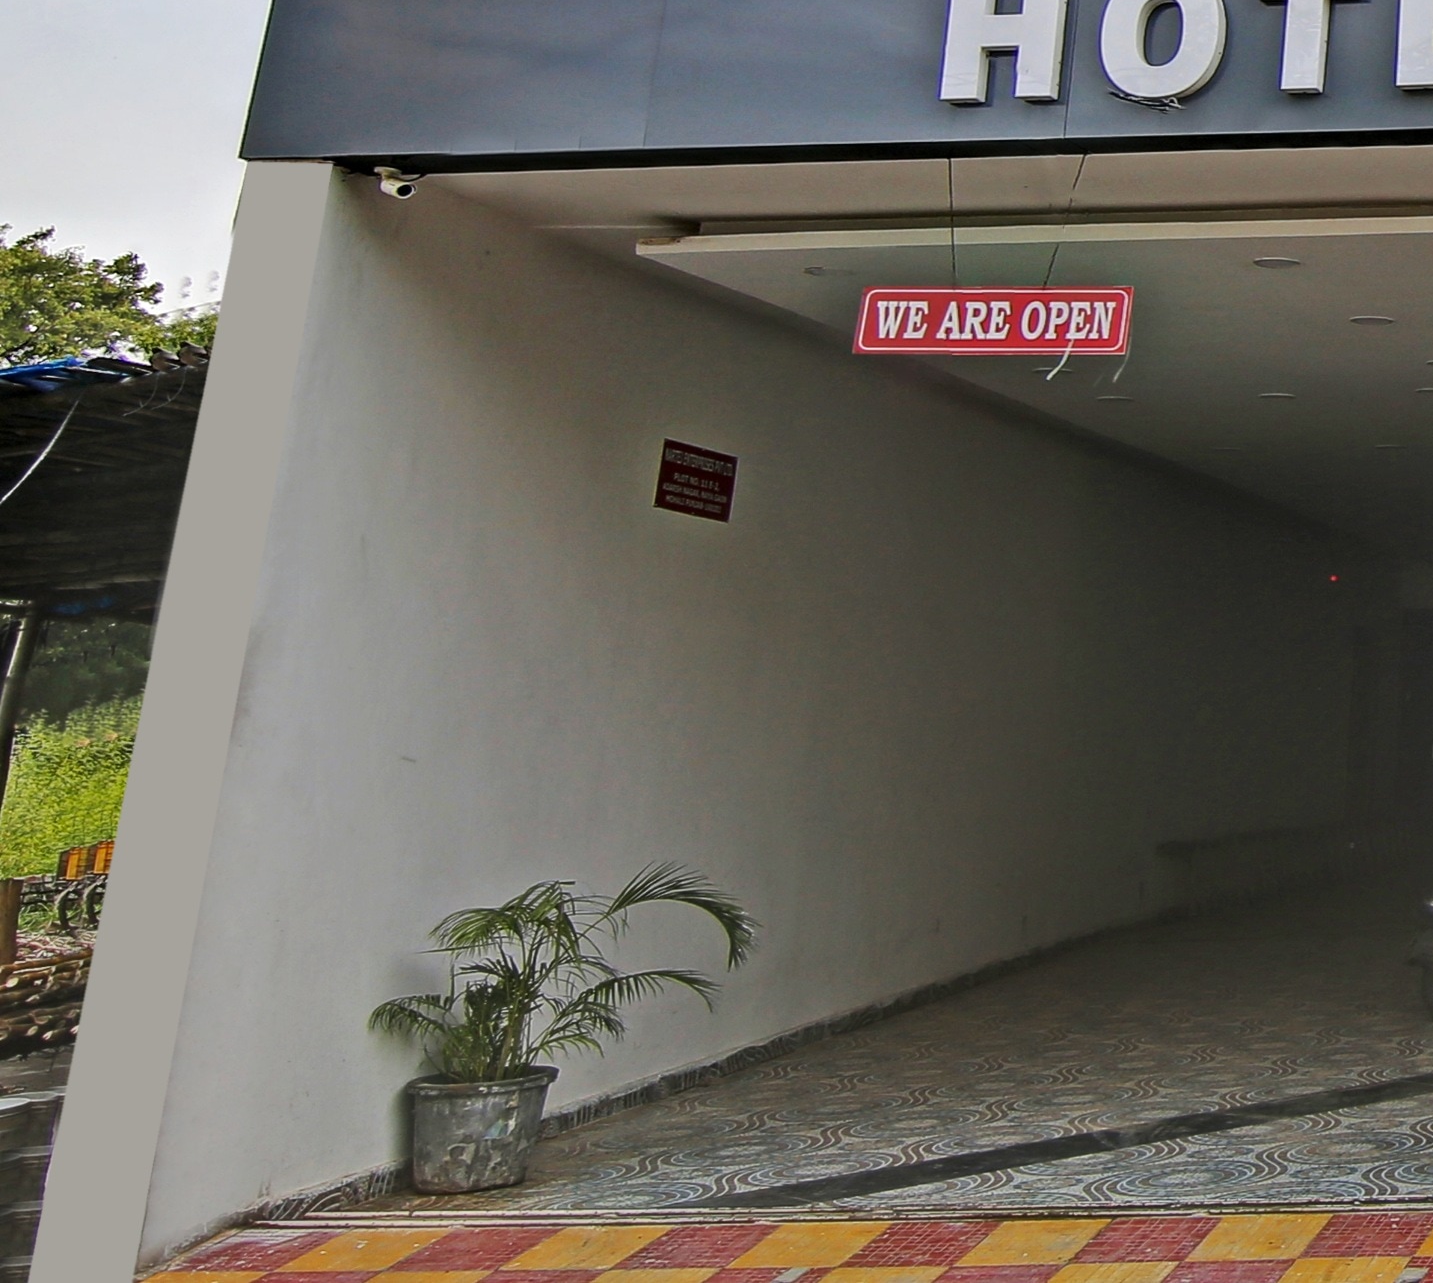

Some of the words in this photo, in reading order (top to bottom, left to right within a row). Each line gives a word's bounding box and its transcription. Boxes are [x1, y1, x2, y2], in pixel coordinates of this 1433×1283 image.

[877, 300, 929, 340] WE
[935, 300, 1011, 340] ARE
[1020, 300, 1117, 340] OPEN
